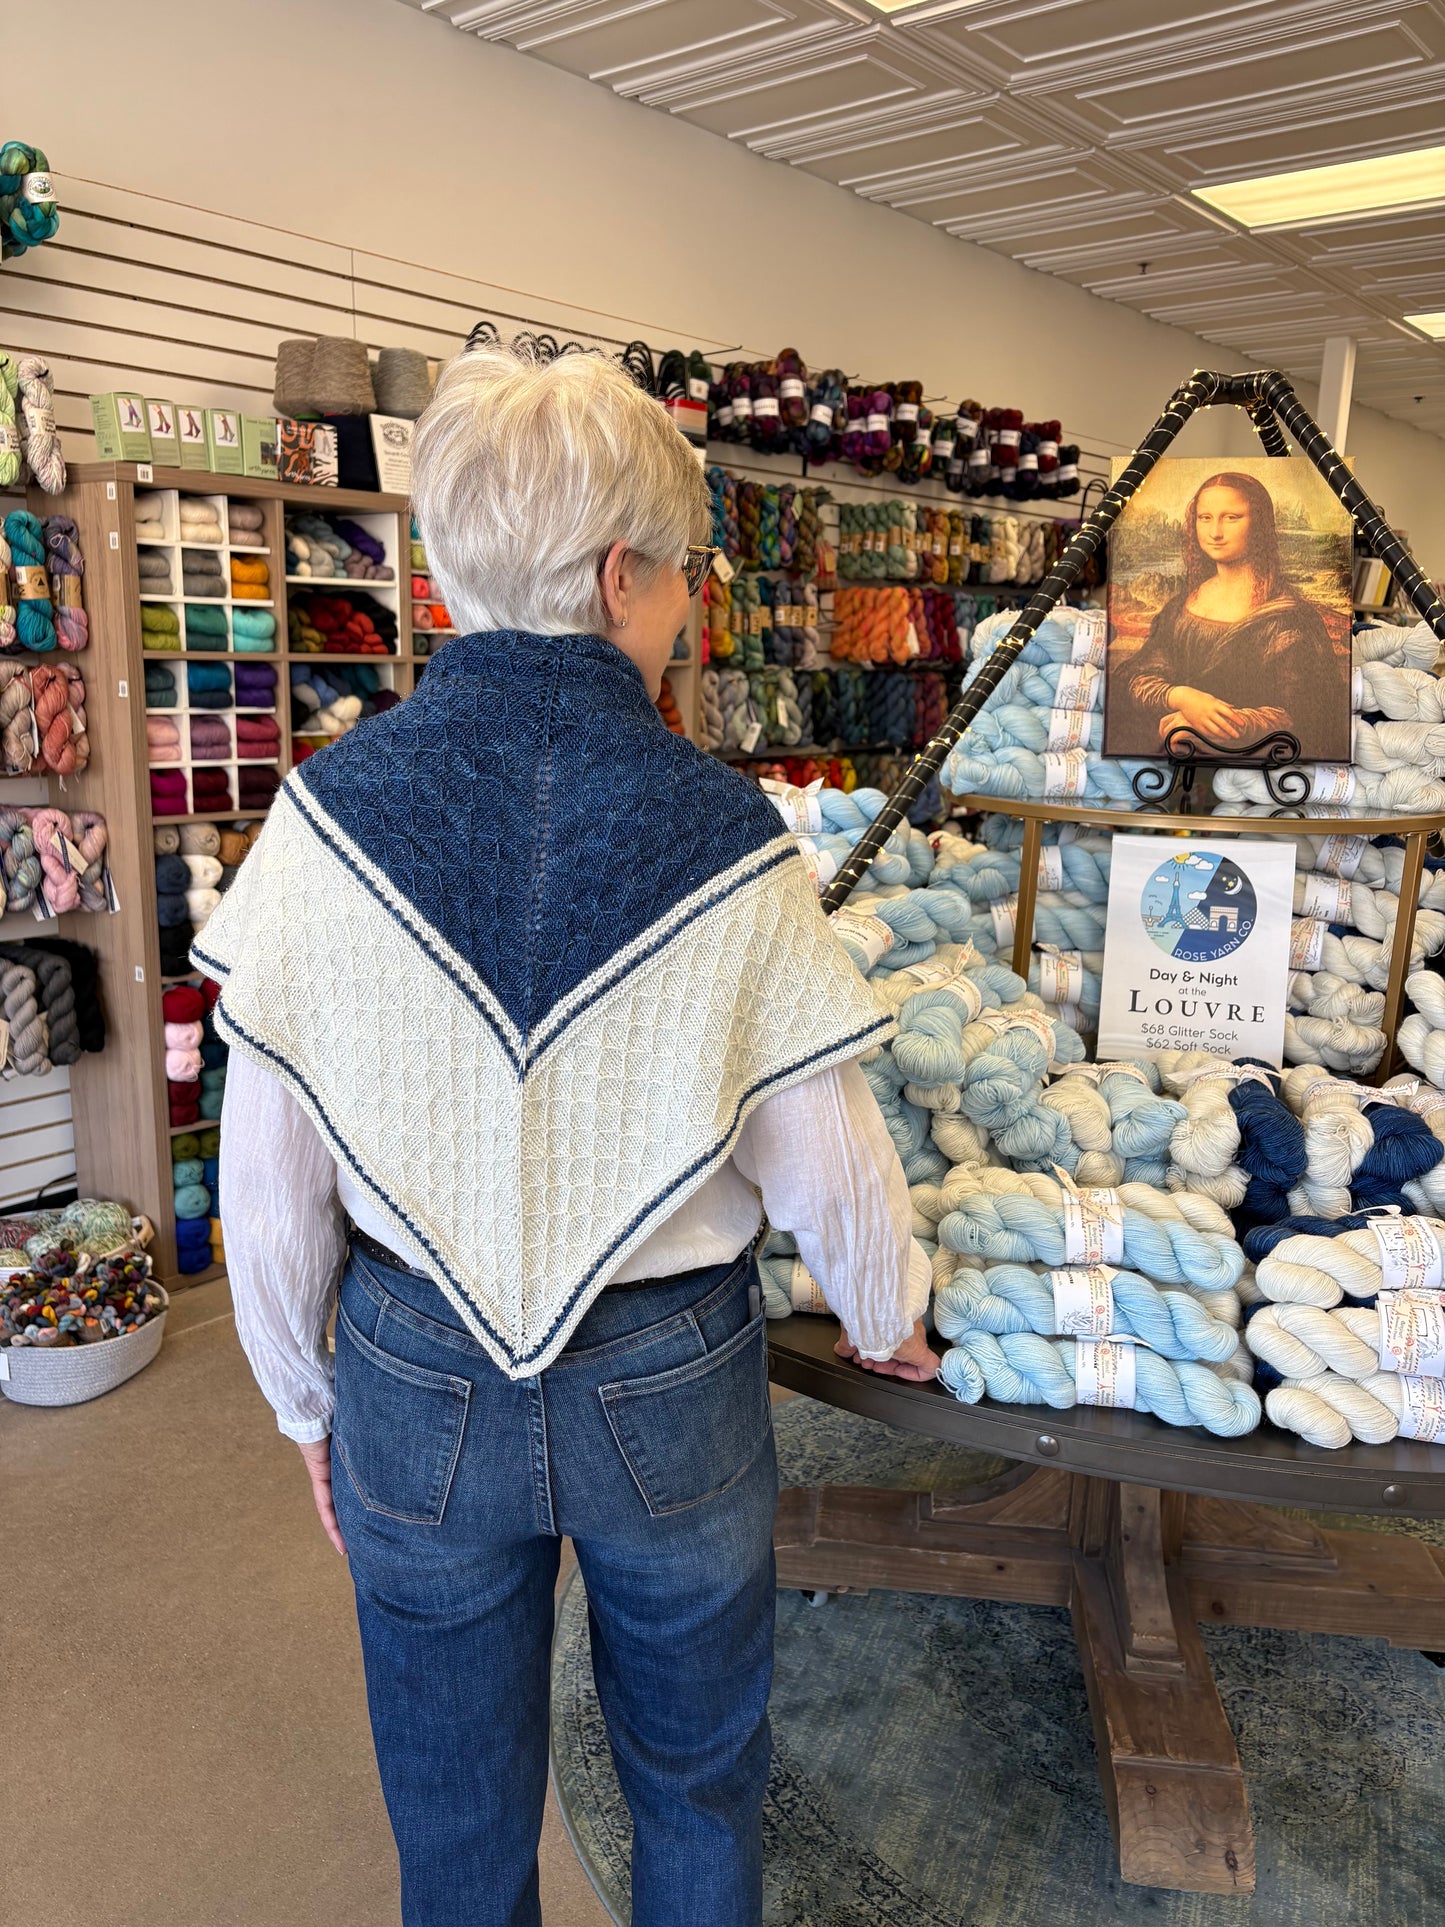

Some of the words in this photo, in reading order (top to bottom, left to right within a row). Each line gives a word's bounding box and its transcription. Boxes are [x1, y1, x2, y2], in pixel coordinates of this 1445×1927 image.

[1174, 948, 1208, 962] ROSE
[1210, 938, 1240, 958] YARN
[1238, 918, 1254, 938] CO.
[1150, 968, 1178, 982] Day
[1182, 971, 1194, 982] &
[1199, 972, 1239, 987] Night
[1178, 987, 1189, 996] at
[1191, 987, 1207, 997] the
[1128, 989, 1265, 1023] LOUVRE
[1141, 1023, 1165, 1035] $68
[1168, 1025, 1205, 1038] Glitter
[1209, 1029, 1239, 1041] Sock
[1146, 1038, 1170, 1050] $62
[1173, 1039, 1198, 1052] Soft
[1202, 1042, 1231, 1055] Sock
